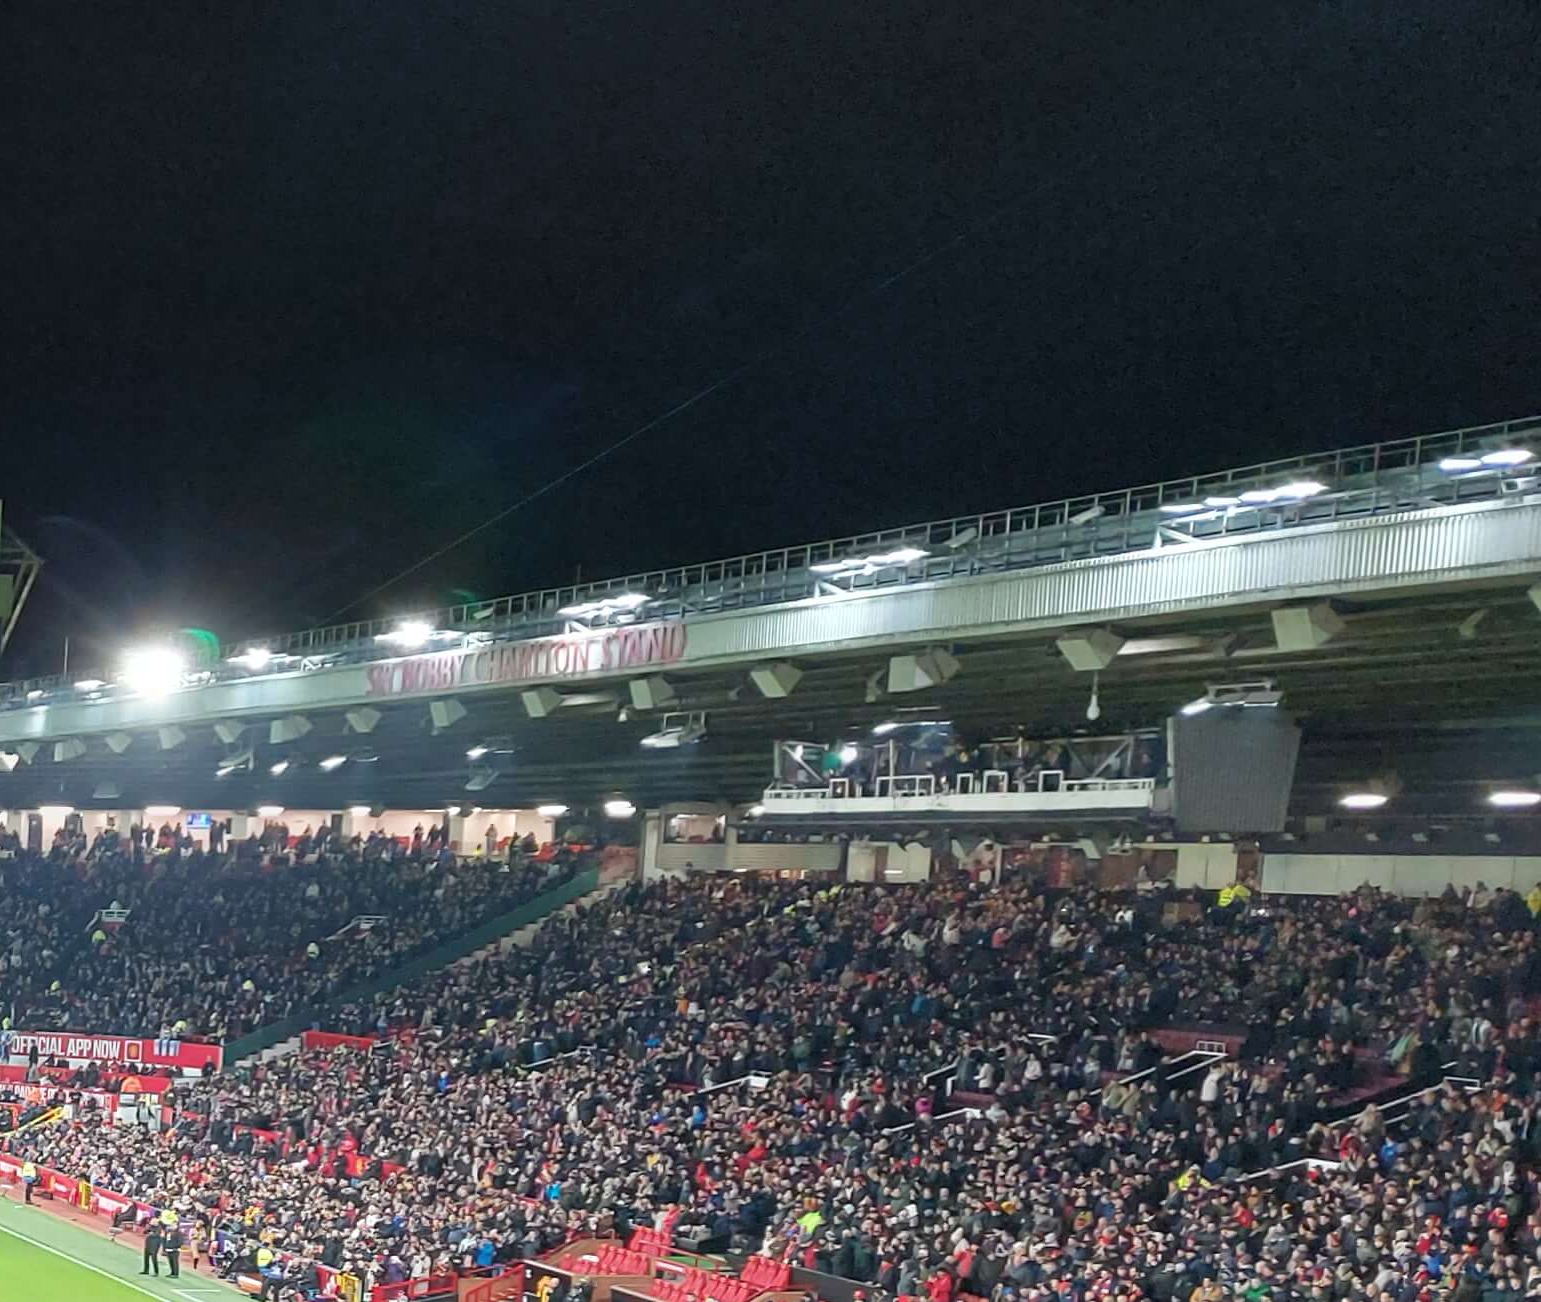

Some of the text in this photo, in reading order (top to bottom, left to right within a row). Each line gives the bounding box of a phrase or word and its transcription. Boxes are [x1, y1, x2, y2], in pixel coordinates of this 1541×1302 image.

[365, 622, 688, 696] SIR BOBBY CHARLTON STAND
[67, 1038, 92, 1058] APP
[94, 1040, 120, 1059] NOW
